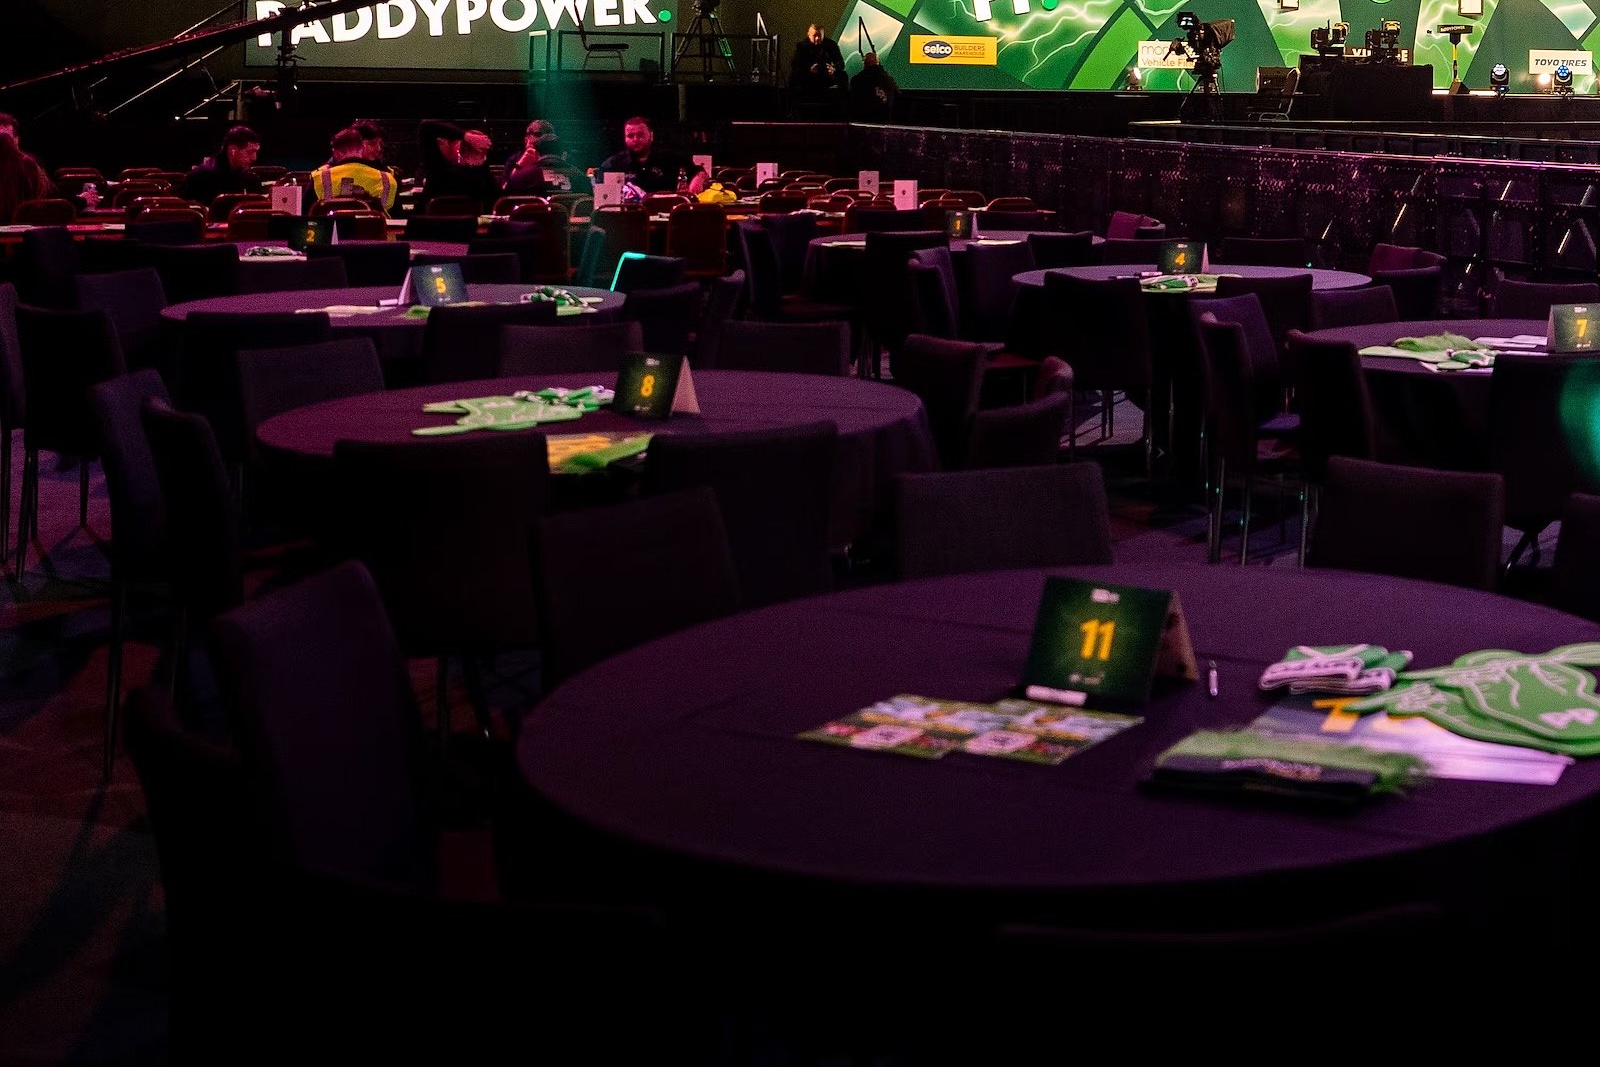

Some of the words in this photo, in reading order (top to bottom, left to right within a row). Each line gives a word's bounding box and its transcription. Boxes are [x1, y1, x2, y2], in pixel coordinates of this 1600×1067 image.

[924, 44, 952, 55] selco
[1535, 58, 1560, 66] TOYO
[1561, 59, 1588, 67] TIRES
[306, 229, 316, 242] 2
[1175, 252, 1186, 265] 4
[435, 277, 447, 294] 5
[1576, 319, 1588, 338] 7
[641, 374, 655, 397] 8
[1079, 618, 1117, 661] 11
